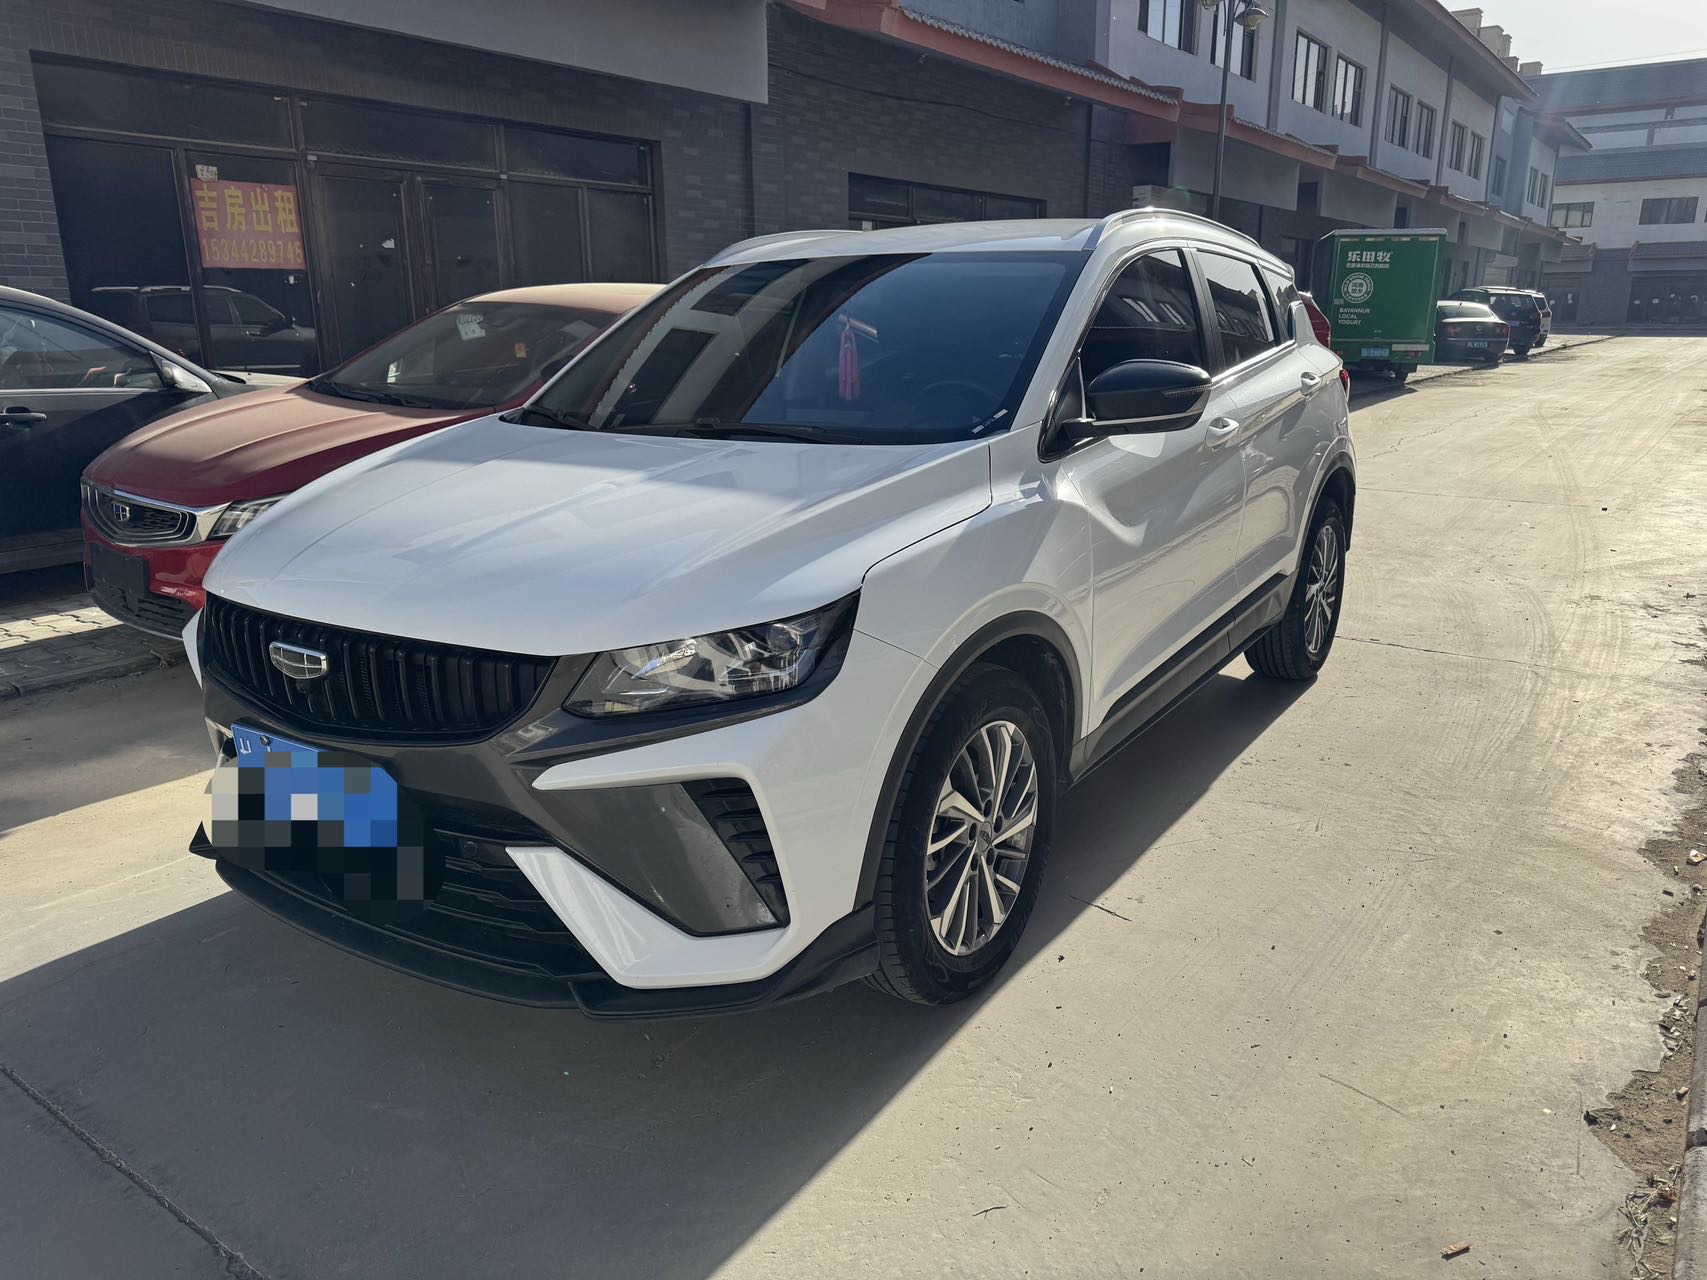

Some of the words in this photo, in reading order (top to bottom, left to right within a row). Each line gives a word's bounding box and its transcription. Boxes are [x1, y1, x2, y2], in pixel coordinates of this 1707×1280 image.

[195, 184, 299, 234] 吉房出租
[202, 238, 303, 262] 15344289745
[1348, 251, 1392, 262] 乐田牧
